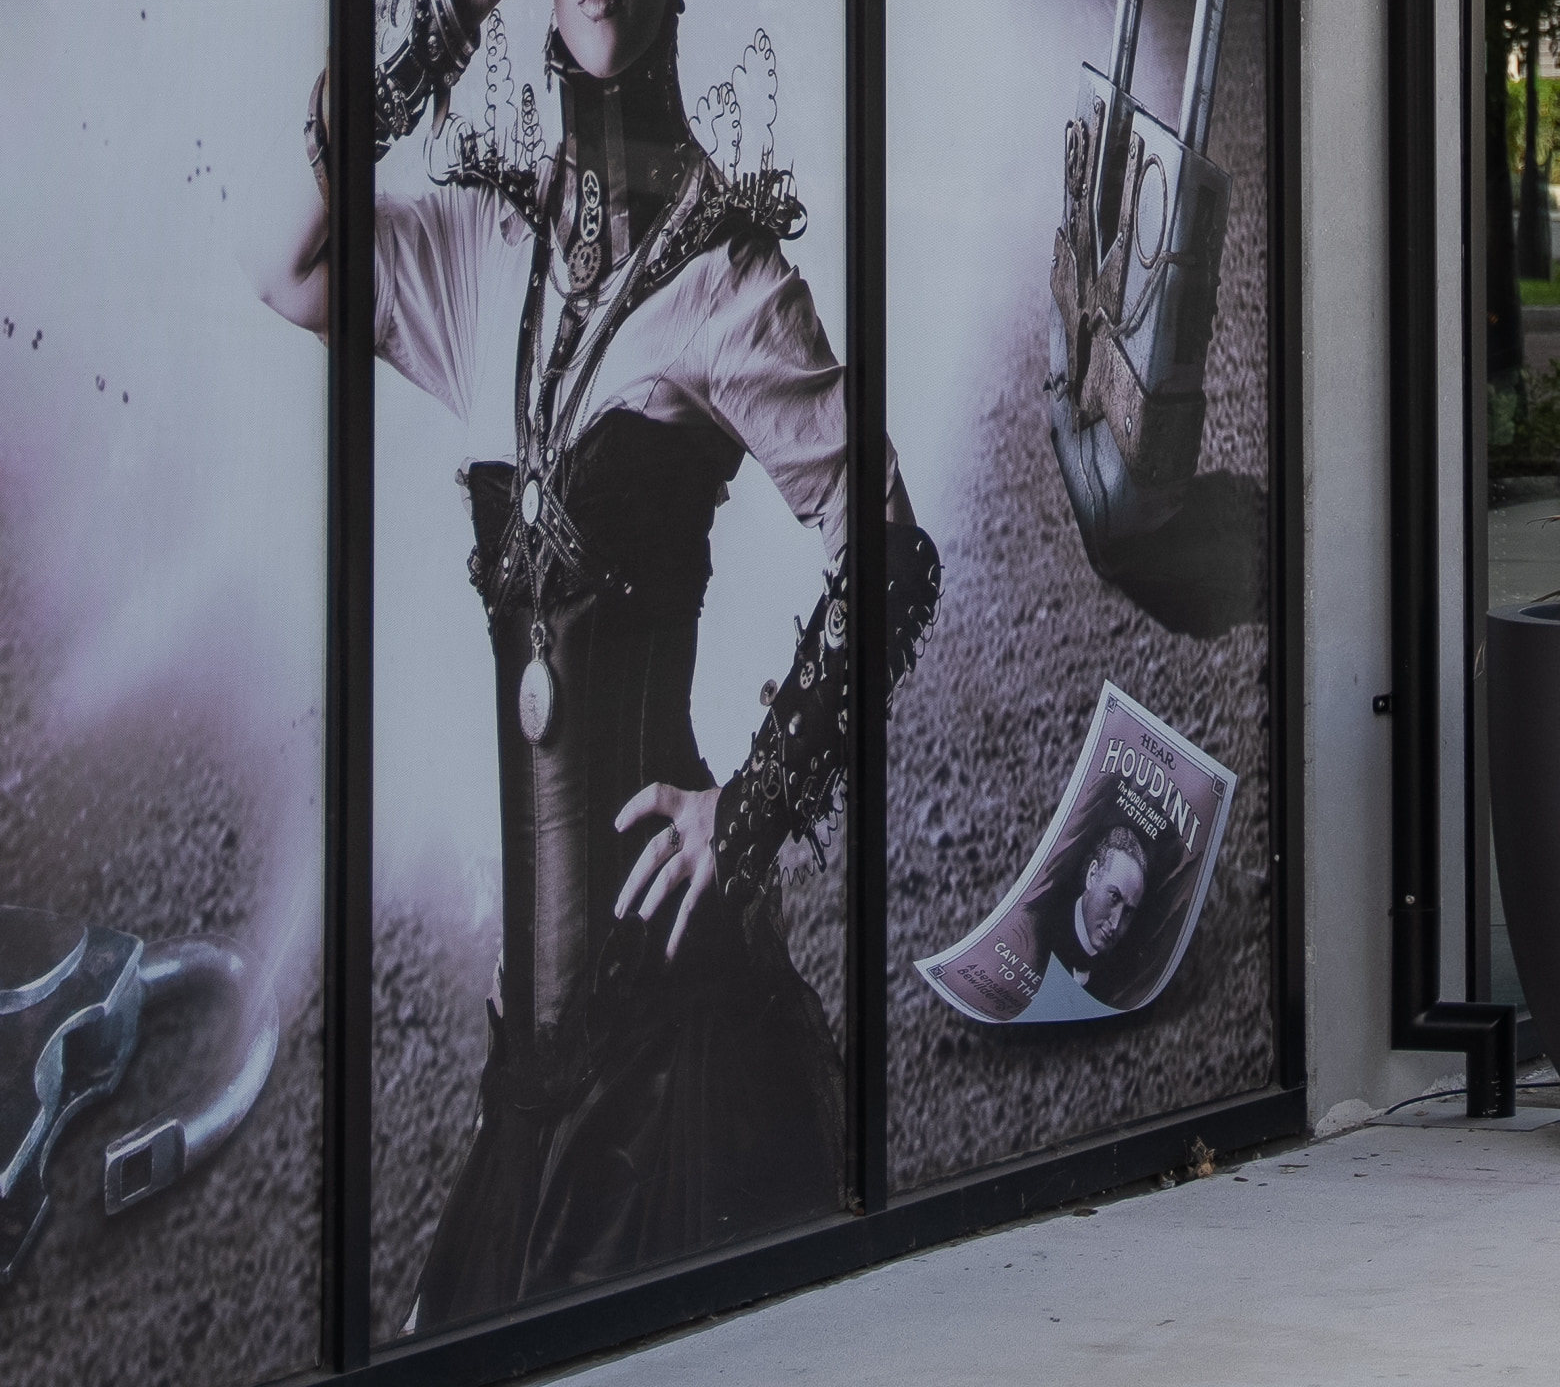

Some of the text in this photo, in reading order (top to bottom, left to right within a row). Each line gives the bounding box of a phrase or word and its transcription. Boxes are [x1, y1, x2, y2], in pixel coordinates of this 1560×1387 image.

[1139, 733, 1177, 770] HEAR
[1099, 738, 1201, 854] HOUDINI
[1116, 796, 1158, 840] MYSTIFIER
[998, 964, 1037, 1000] TO TH
[1019, 963, 1042, 985] THE
